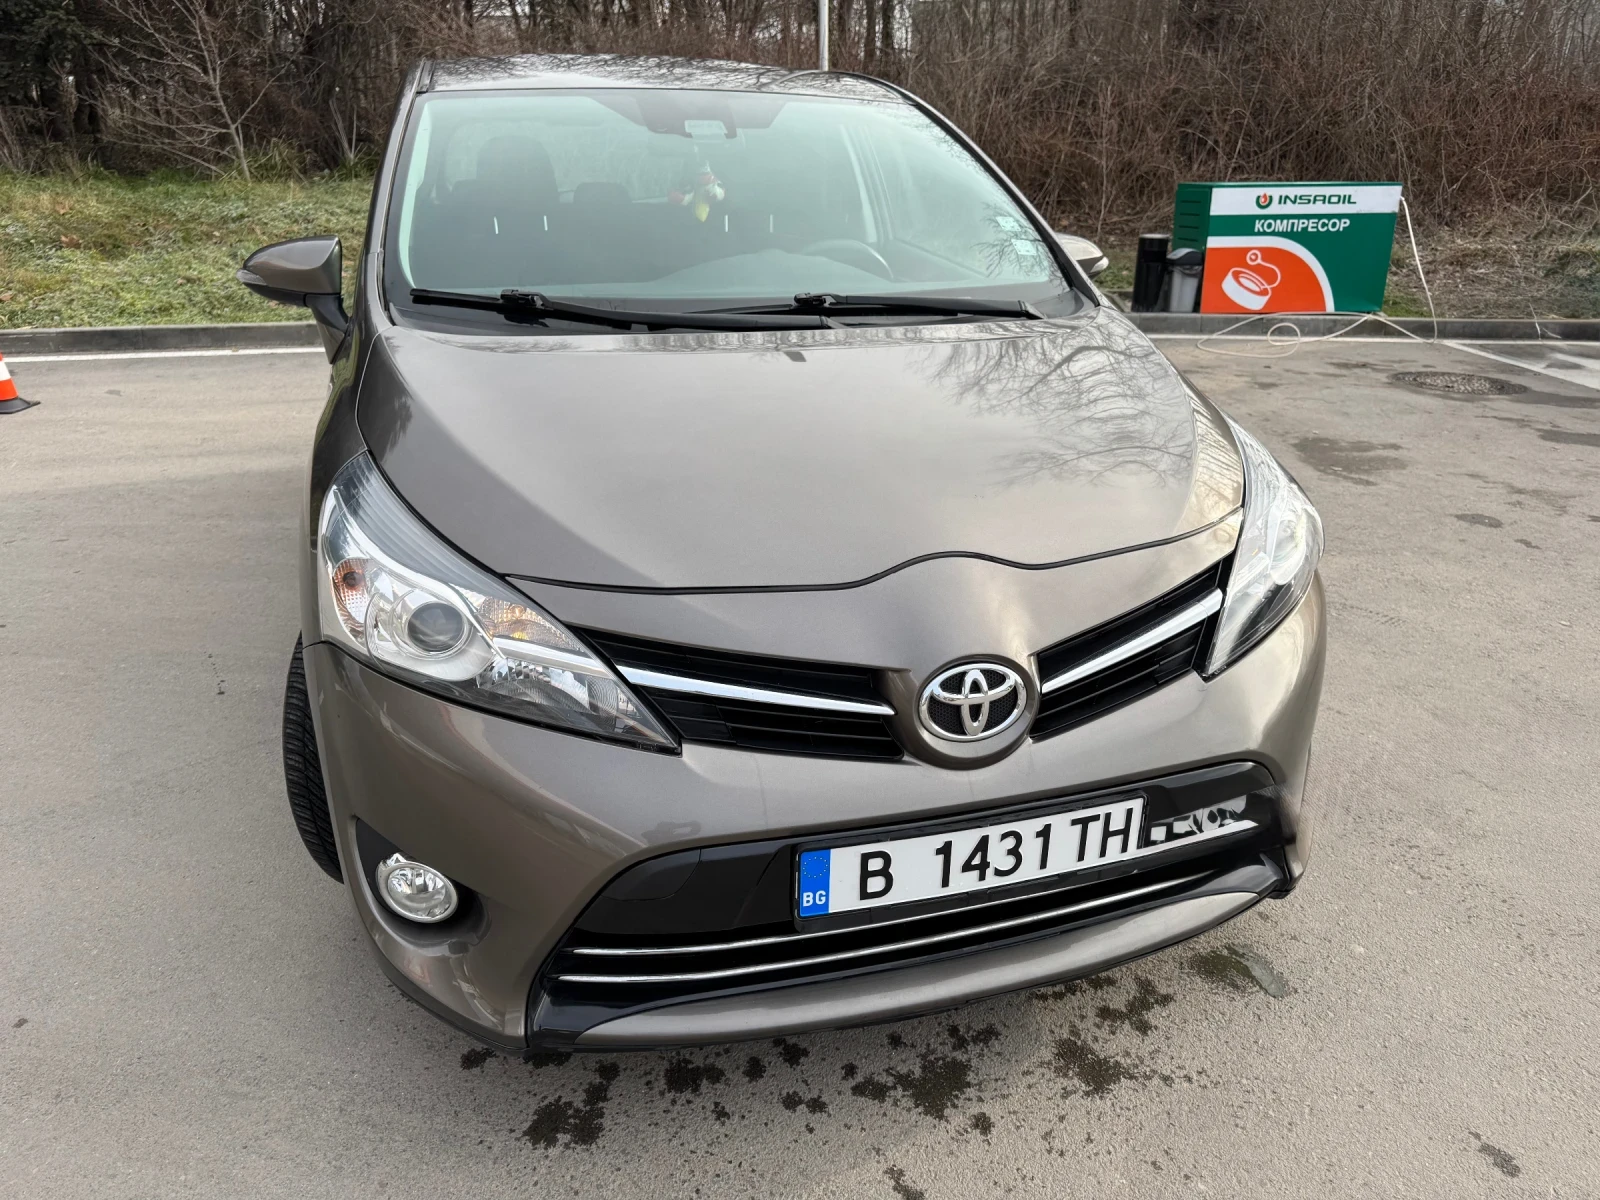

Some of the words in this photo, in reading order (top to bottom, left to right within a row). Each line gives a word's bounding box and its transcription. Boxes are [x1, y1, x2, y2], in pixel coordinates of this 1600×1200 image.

[1277, 194, 1357, 205] INSAOIL
[1254, 218, 1350, 232] КОМПРЕСОР
[859, 850, 894, 901] B
[934, 823, 1052, 888] 1431
[1070, 808, 1133, 862] TH
[802, 889, 827, 907] BG
